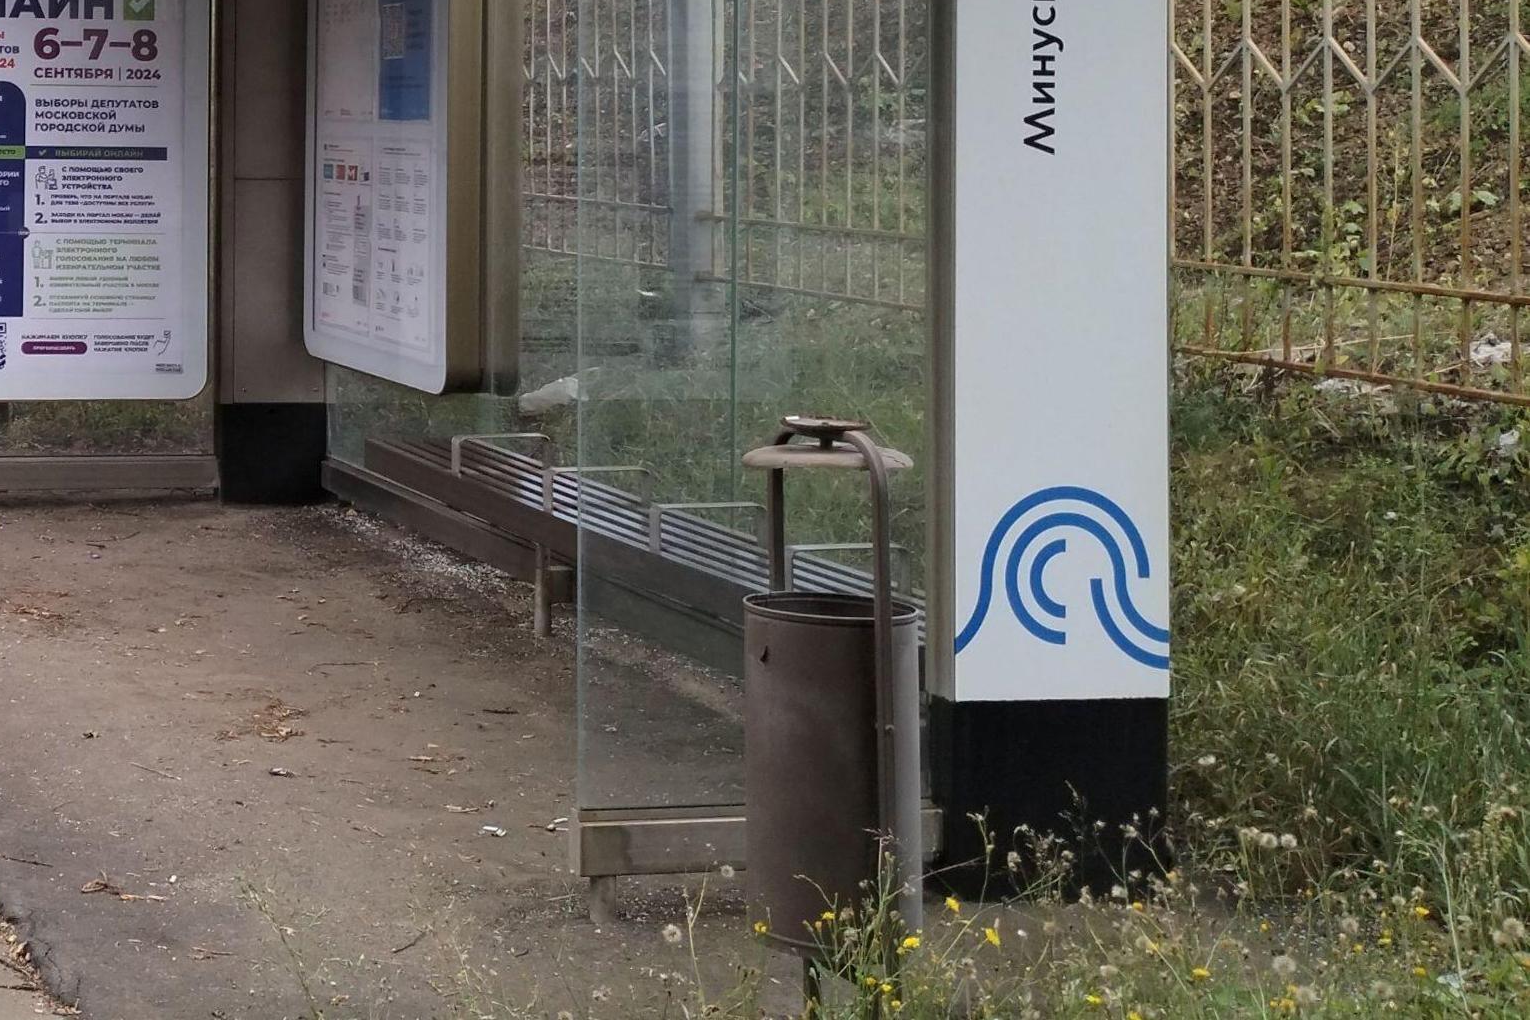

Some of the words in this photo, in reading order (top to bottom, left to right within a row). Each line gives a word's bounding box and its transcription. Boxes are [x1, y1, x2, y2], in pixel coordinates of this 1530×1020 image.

[34, 67, 113, 79] СЕНТЯБРЯ
[126, 69, 162, 80] 2024
[35, 99, 88, 108] ВЫБОРЫ
[91, 99, 160, 109] ДЕПУТАТОВ
[35, 110, 117, 120] МОСКОВСКОЙ
[35, 122, 105, 132] ГОРОДСКОЙ
[108, 124, 145, 133] ДУМЫ
[55, 148, 103, 157] ВЫБИРАЙ
[104, 149, 144, 158] ОНЛАЙН
[68, 166, 113, 174] ПОМОЩЬЮ
